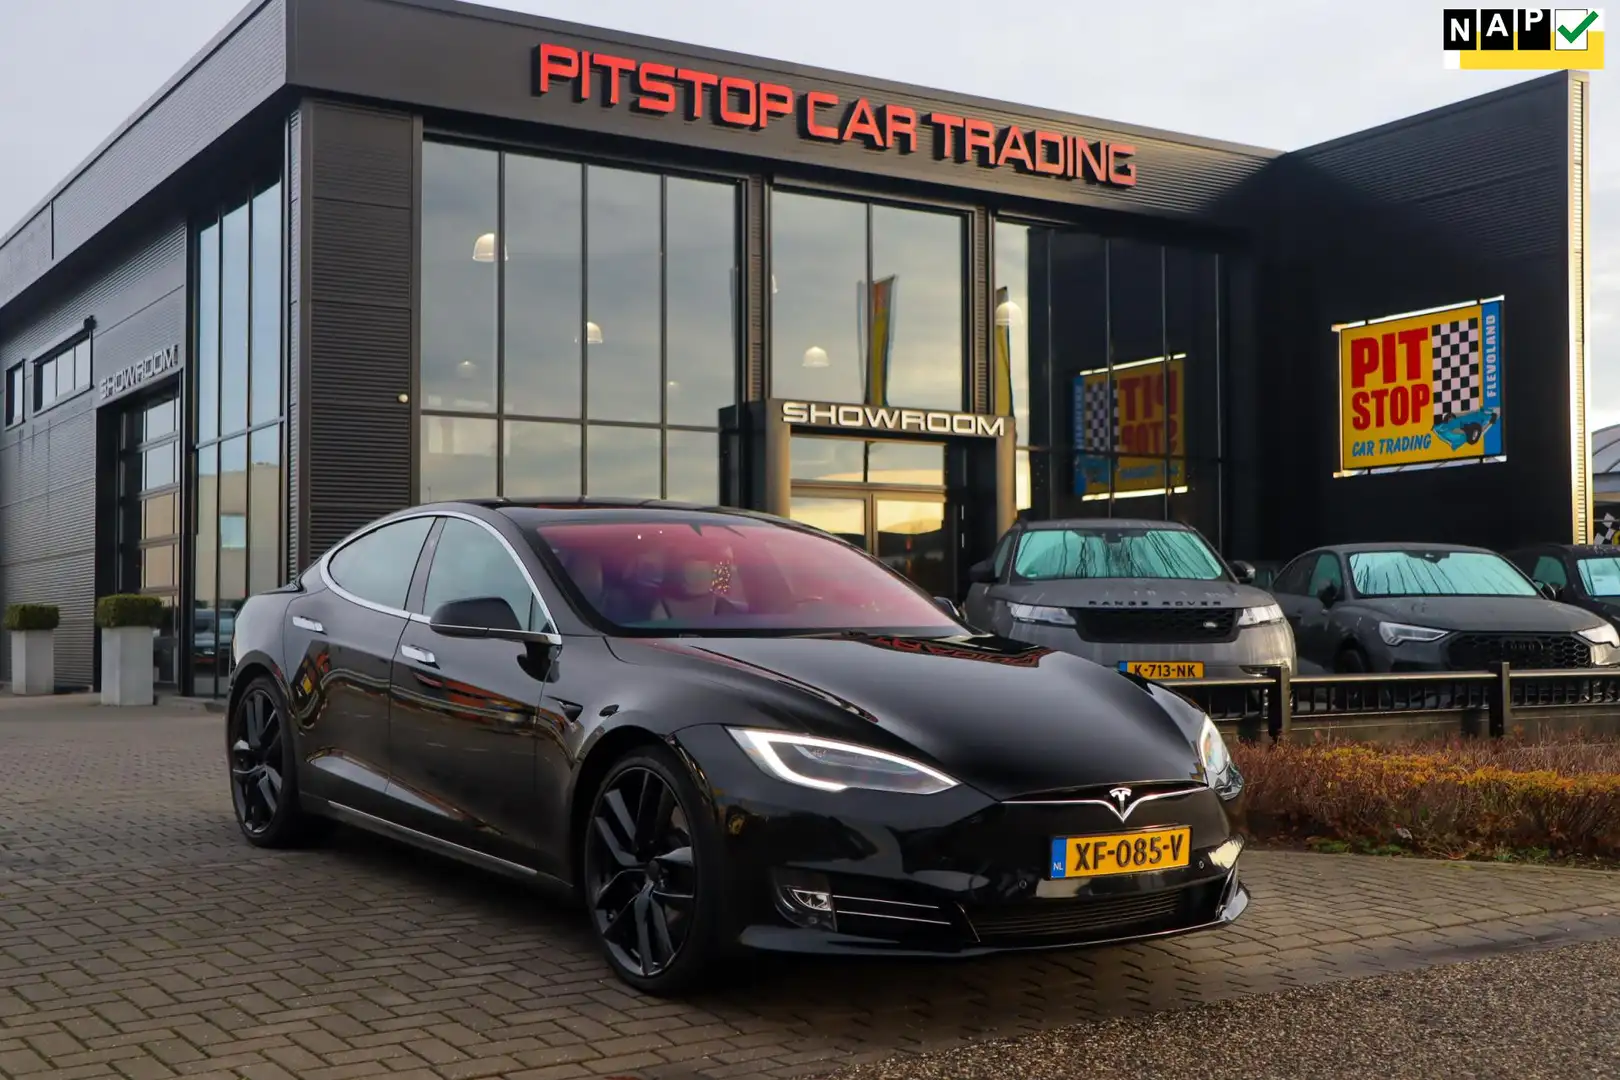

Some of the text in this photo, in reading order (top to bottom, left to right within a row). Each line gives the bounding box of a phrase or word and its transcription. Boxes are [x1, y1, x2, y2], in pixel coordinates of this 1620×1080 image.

[539, 43, 1137, 187] PITSTOP CAR TRADING
[100, 343, 179, 400] SHOWROOM
[1351, 327, 1429, 389] PIT
[1486, 314, 1497, 398] FLEVOLAND
[782, 401, 1005, 437] SHOWROOM
[1352, 383, 1430, 431] STOP
[1352, 433, 1432, 458] CAR TRADING
[1134, 663, 1196, 678] K-713-NK
[1053, 862, 1064, 872] NL
[1074, 834, 1184, 872] XF-085-V
